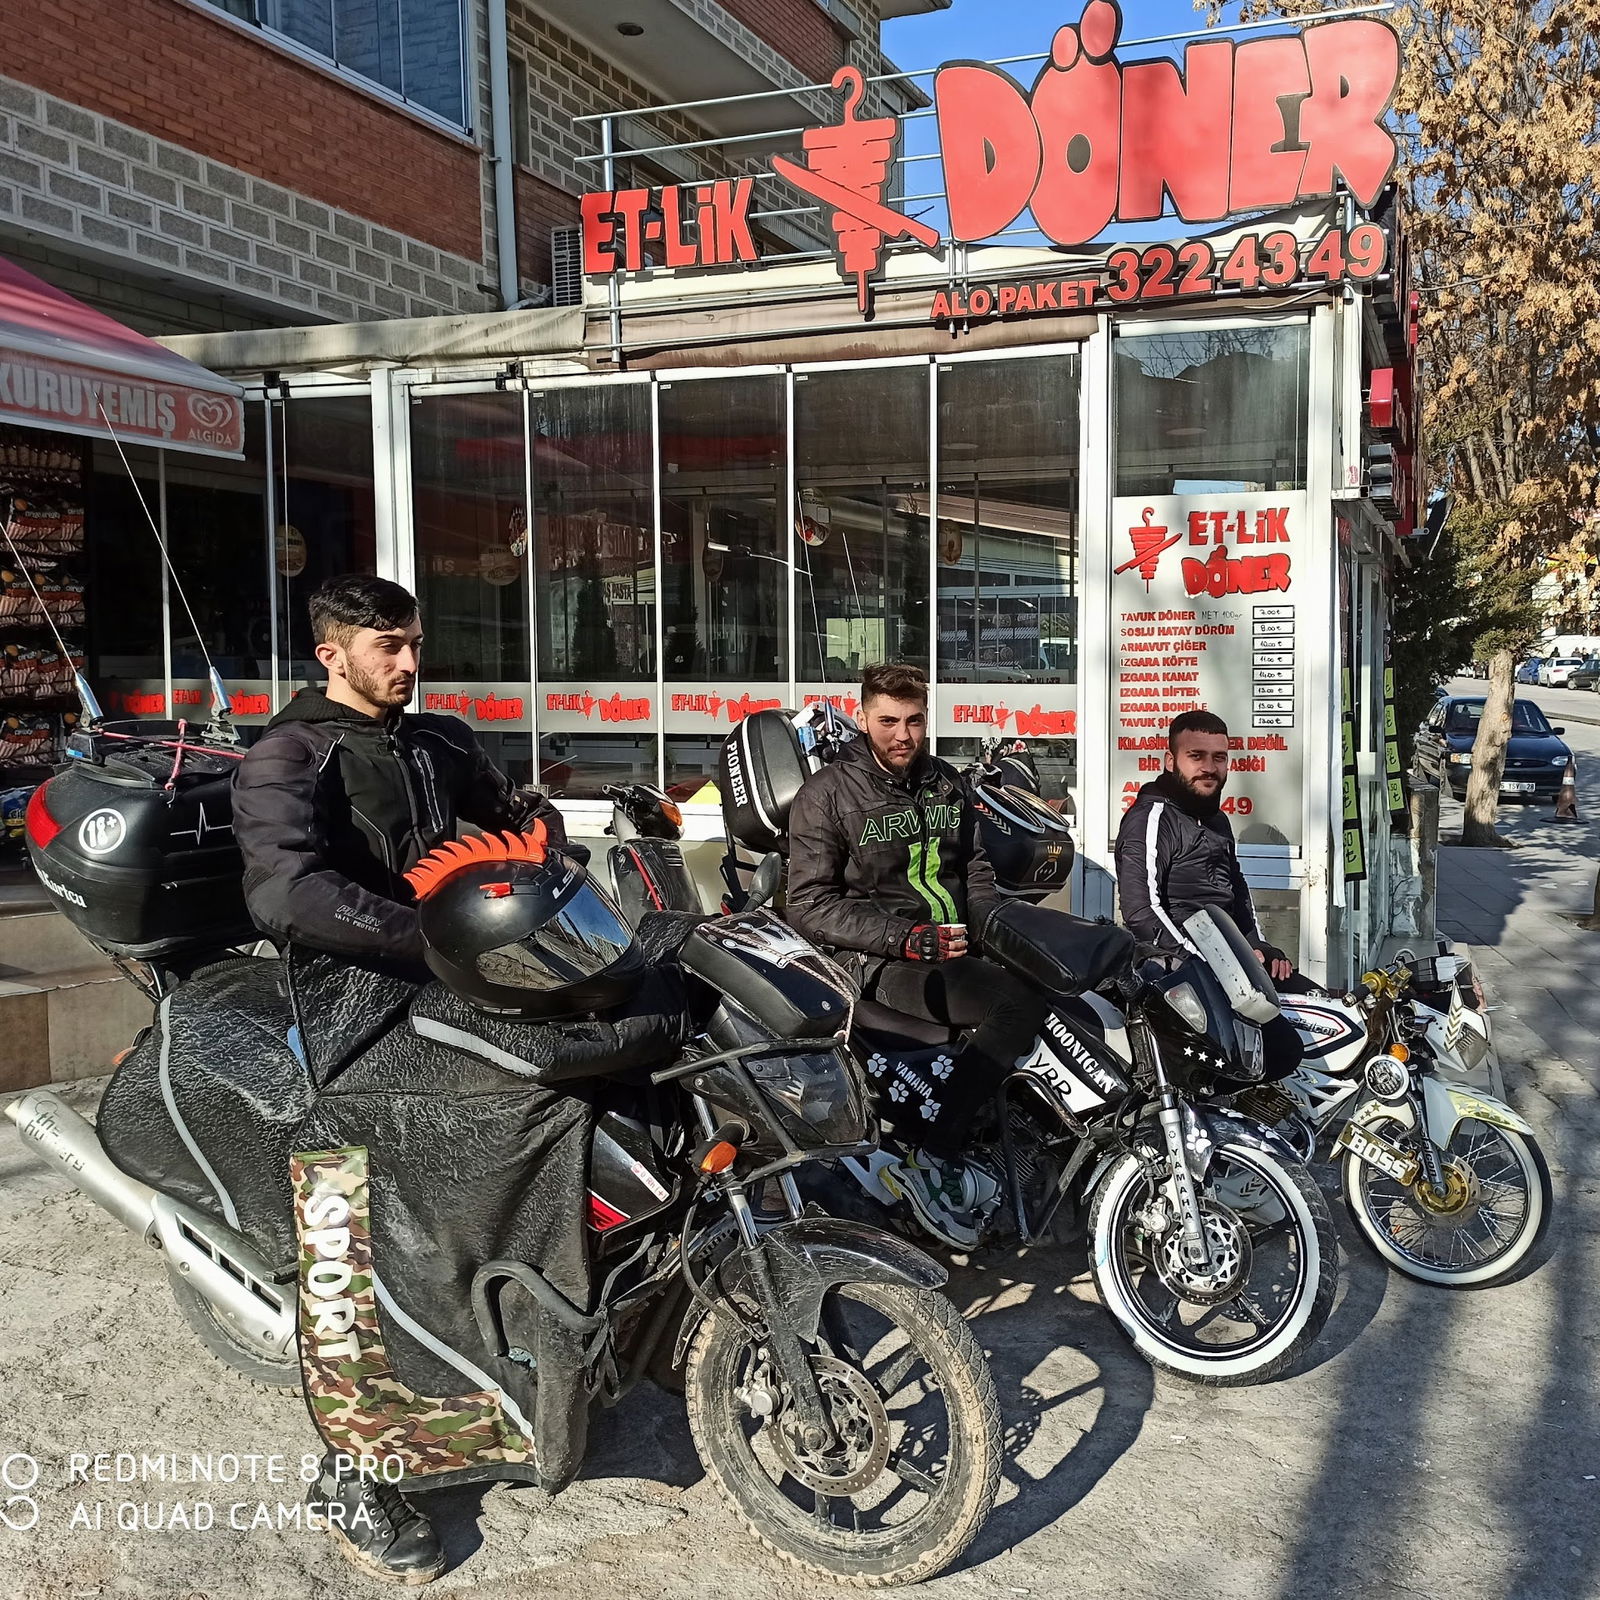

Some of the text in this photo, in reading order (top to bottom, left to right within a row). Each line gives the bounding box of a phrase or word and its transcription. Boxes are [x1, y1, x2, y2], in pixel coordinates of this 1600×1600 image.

[935, 0, 1400, 246] DÖNER
[931, 223, 1386, 320] ALO PAKET 322 43 49
[1181, 545, 1292, 598] DÖNER
[1120, 612, 1156, 621] TAVUK
[1158, 610, 1196, 620] DÖNER
[1120, 624, 1235, 636] SOSLU HATAY DÜRÜM
[1120, 640, 1207, 653] ARNAVUT ÇİĞER
[1162, 655, 1198, 666] KÖFTE
[1162, 672, 1199, 681] KANAT
[1162, 685, 1200, 697] BİFTEK
[474, 692, 523, 722] DÖNER
[598, 692, 651, 722] DÖNER
[1014, 704, 1077, 736] DÖNER
[1162, 700, 1208, 712] BONFİLE
[1120, 718, 1156, 727] TAVUK
[1247, 734, 1288, 750] DEĞİL
[726, 740, 748, 808] PIONEER
[1138, 755, 1266, 772] BİR ASİĞİ
[86, 815, 118, 848] 18+
[1045, 1013, 1117, 1095] HOONIGAN
[895, 1061, 934, 1099] YAMAHA
[1349, 1132, 1409, 1179] BOSS
[1171, 1148, 1193, 1220] YAMAHA
[303, 1195, 362, 1363] SPORT
